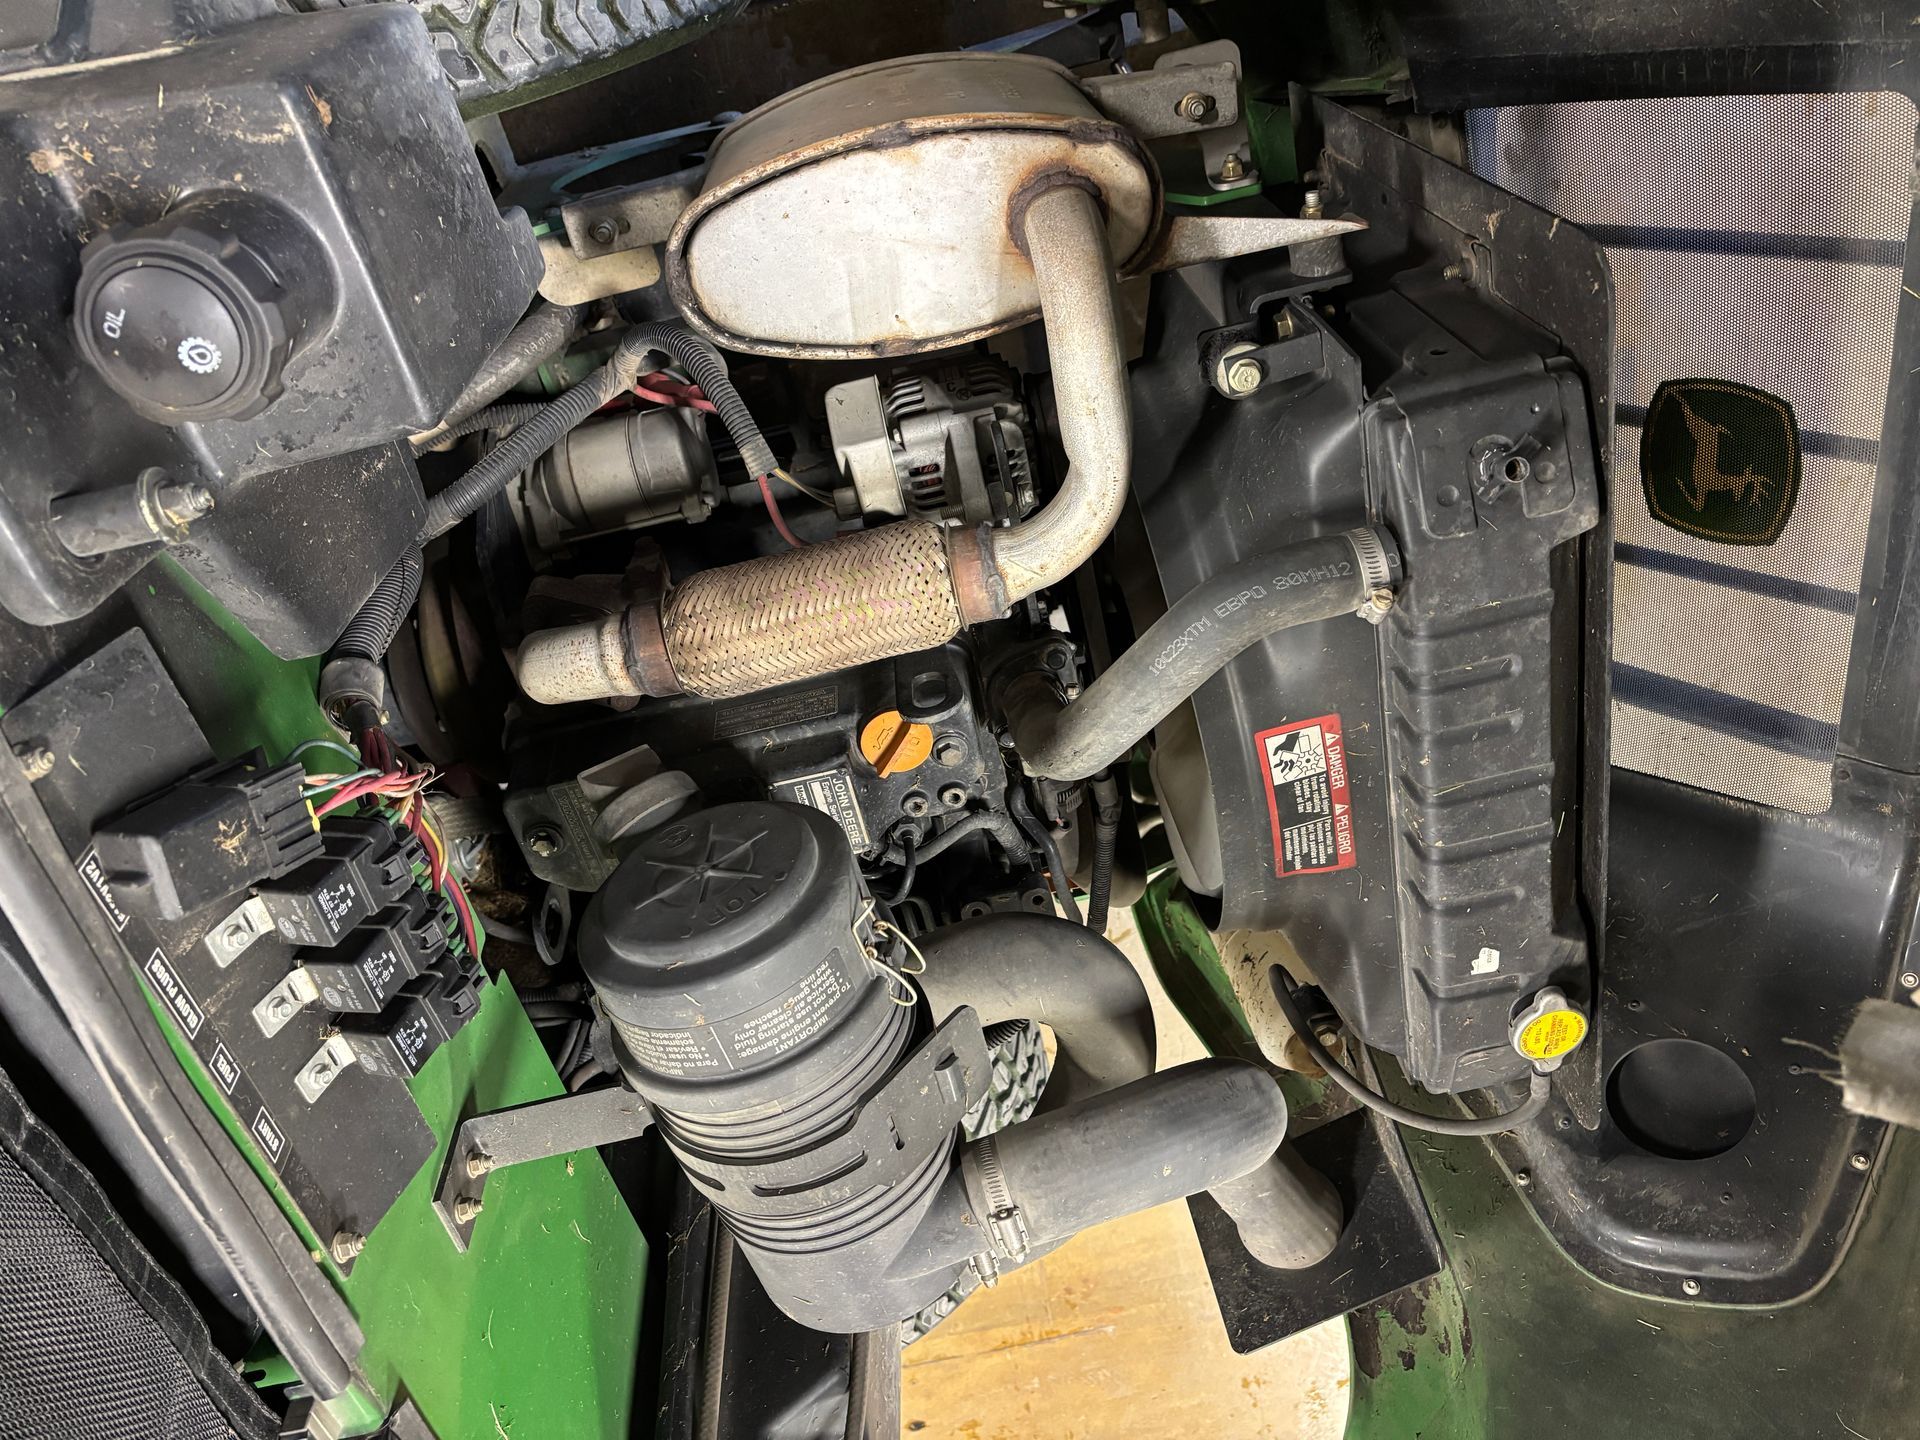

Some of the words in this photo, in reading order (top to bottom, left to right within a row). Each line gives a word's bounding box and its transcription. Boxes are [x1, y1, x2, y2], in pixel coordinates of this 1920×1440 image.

[102, 308, 126, 339] OIL
[1319, 774, 1326, 782] To
[1328, 745, 1345, 789] DANGER
[821, 781, 834, 804] Engine
[1294, 781, 1303, 797] clear
[1310, 776, 1318, 790] from
[1320, 783, 1328, 799] avoid
[795, 785, 809, 805] Mode
[1313, 791, 1321, 813] rotating
[832, 776, 849, 808] JOHN
[843, 810, 862, 845] DEERE
[1297, 803, 1305, 813] fan
[1305, 801, 1313, 813] stay
[1321, 799, 1330, 815] injury
[1336, 815, 1351, 854] PELIGRO
[316, 893, 329, 914] CANADA
[704, 885, 769, 929] TOP
[150, 958, 179, 998] PLUGS
[816, 961, 830, 975] red
[799, 974, 816, 989] line
[806, 975, 836, 1004] Service
[812, 969, 833, 990] when
[826, 982, 839, 995] Do
[840, 981, 851, 993] To
[174, 993, 199, 1029] GLOW
[793, 1001, 806, 1013] air
[811, 990, 842, 1020] prevent
[812, 993, 827, 1008] not
[743, 1008, 783, 1030] reaches
[757, 1010, 793, 1032] cleaner
[795, 1005, 812, 1020] use
[735, 1029, 756, 1042] only
[757, 1017, 795, 1041] starting
[773, 1015, 829, 1054] IMPORTANT
[780, 1016, 811, 1040] engine
[1573, 1019, 1583, 1043] WARNING
[734, 1037, 758, 1050] fluid
[737, 1037, 779, 1059] damage:
[215, 1053, 235, 1083] FUEL
[257, 1118, 280, 1152] START
